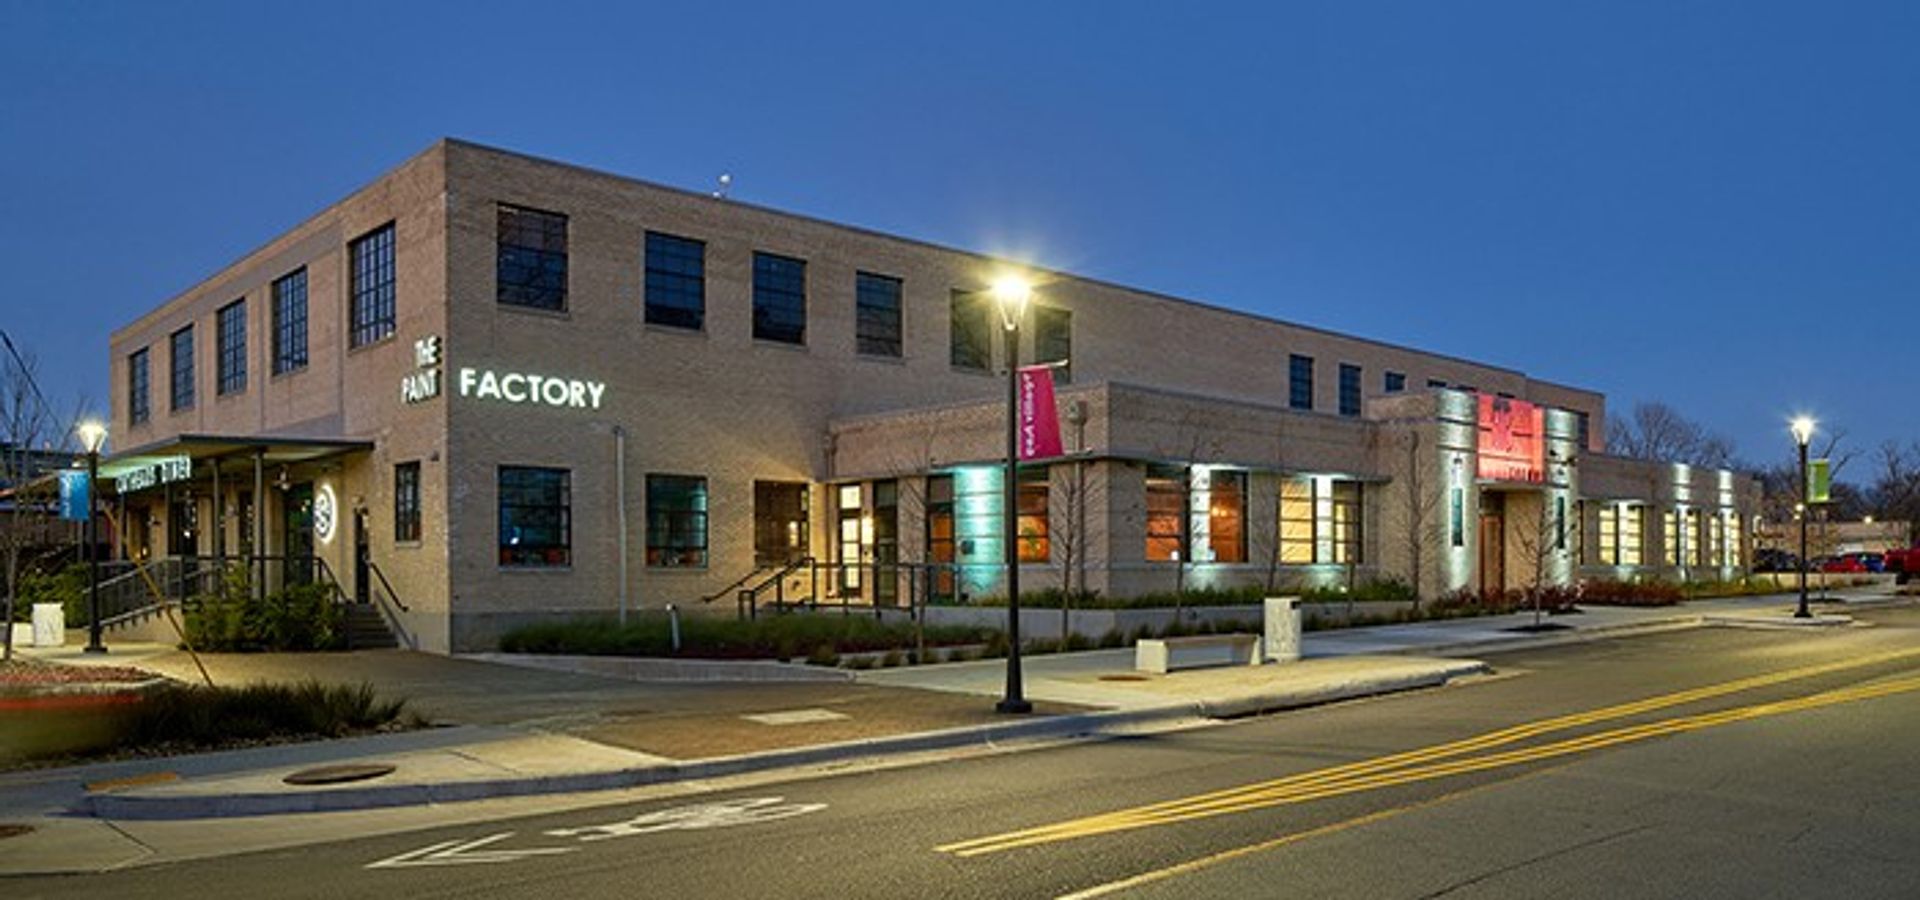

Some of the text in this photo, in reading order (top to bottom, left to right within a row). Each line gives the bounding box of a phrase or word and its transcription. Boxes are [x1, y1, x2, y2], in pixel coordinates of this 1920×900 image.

[414, 335, 441, 367] THE
[401, 368, 441, 403] PAINT
[459, 367, 605, 409] FACTORY
